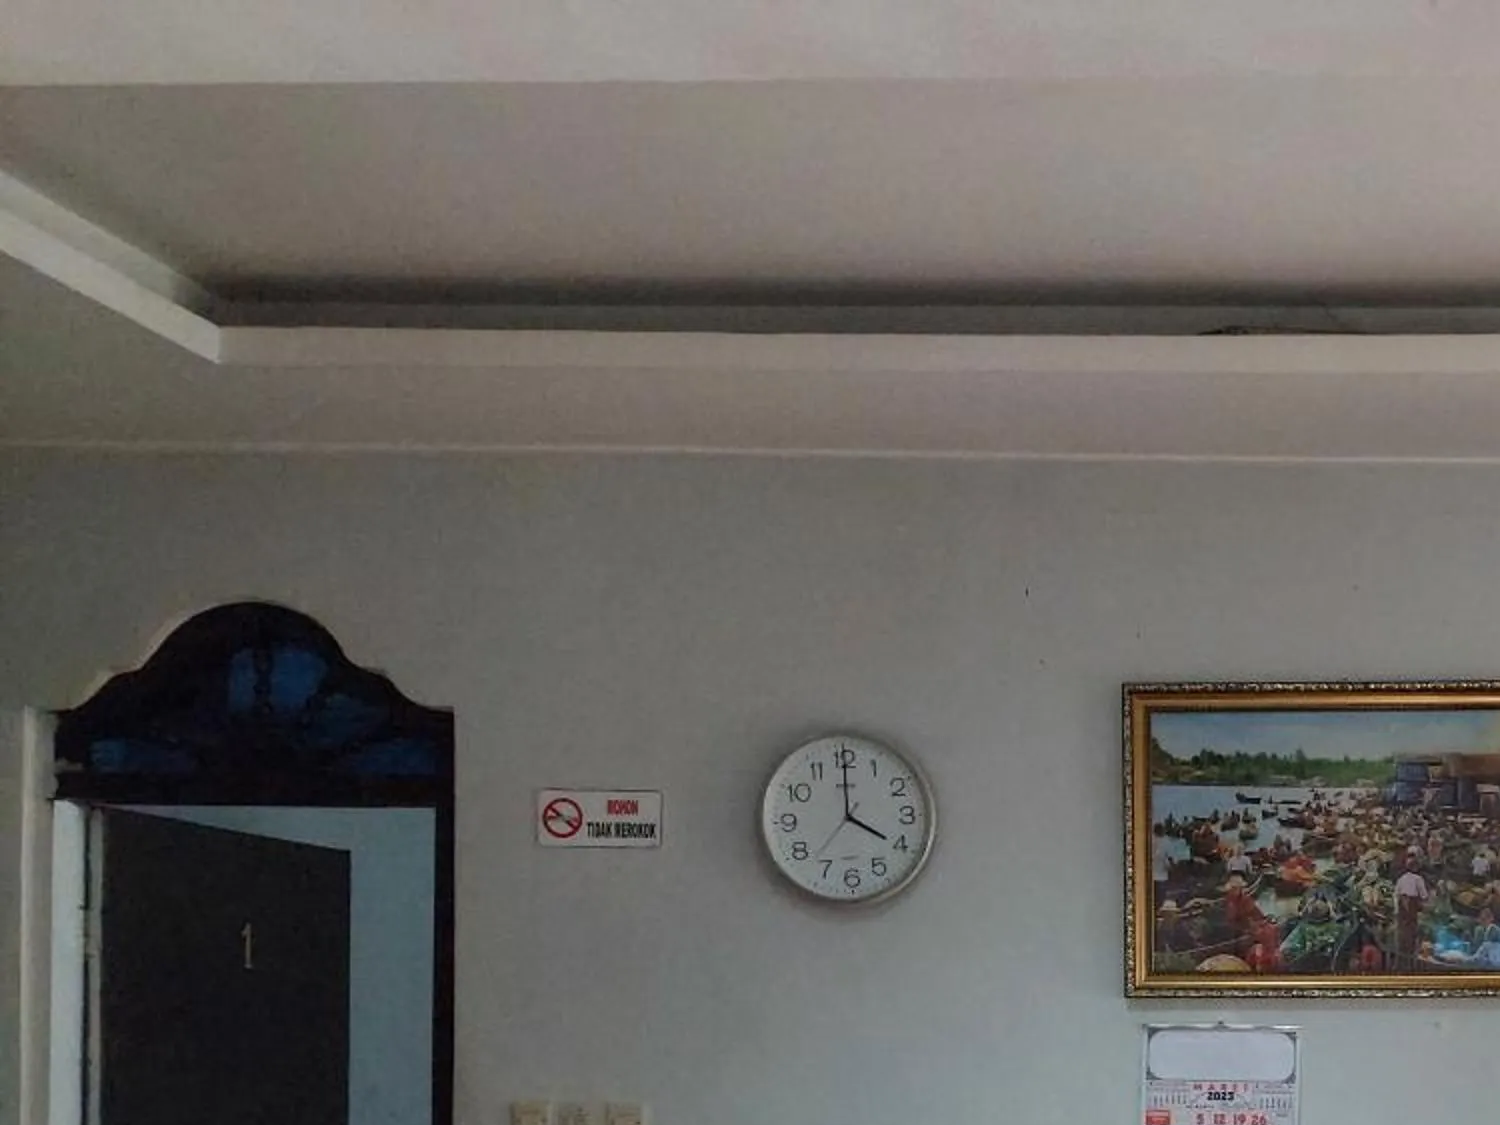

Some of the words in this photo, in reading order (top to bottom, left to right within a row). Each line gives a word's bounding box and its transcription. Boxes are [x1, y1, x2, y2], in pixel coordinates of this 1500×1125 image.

[833, 749, 856, 769] 12
[870, 759, 877, 777] 1
[810, 761, 823, 781] 11
[787, 783, 812, 803] 10
[890, 777, 906, 797] 2
[780, 813, 797, 833] 9
[899, 805, 916, 825] 3
[587, 821, 613, 838] TIDAK
[614, 822, 656, 838] MEROKOK
[791, 841, 809, 860] 8
[892, 835, 908, 852] 4
[818, 860, 833, 879] 7
[871, 857, 887, 877] 5
[843, 868, 861, 889] 6
[241, 922, 252, 969] 1
[1207, 1091, 1235, 1100] 2023
[1196, 1115, 1203, 1125] 5
[1213, 1114, 1226, 1125] 12
[1233, 1115, 1246, 1125] 19
